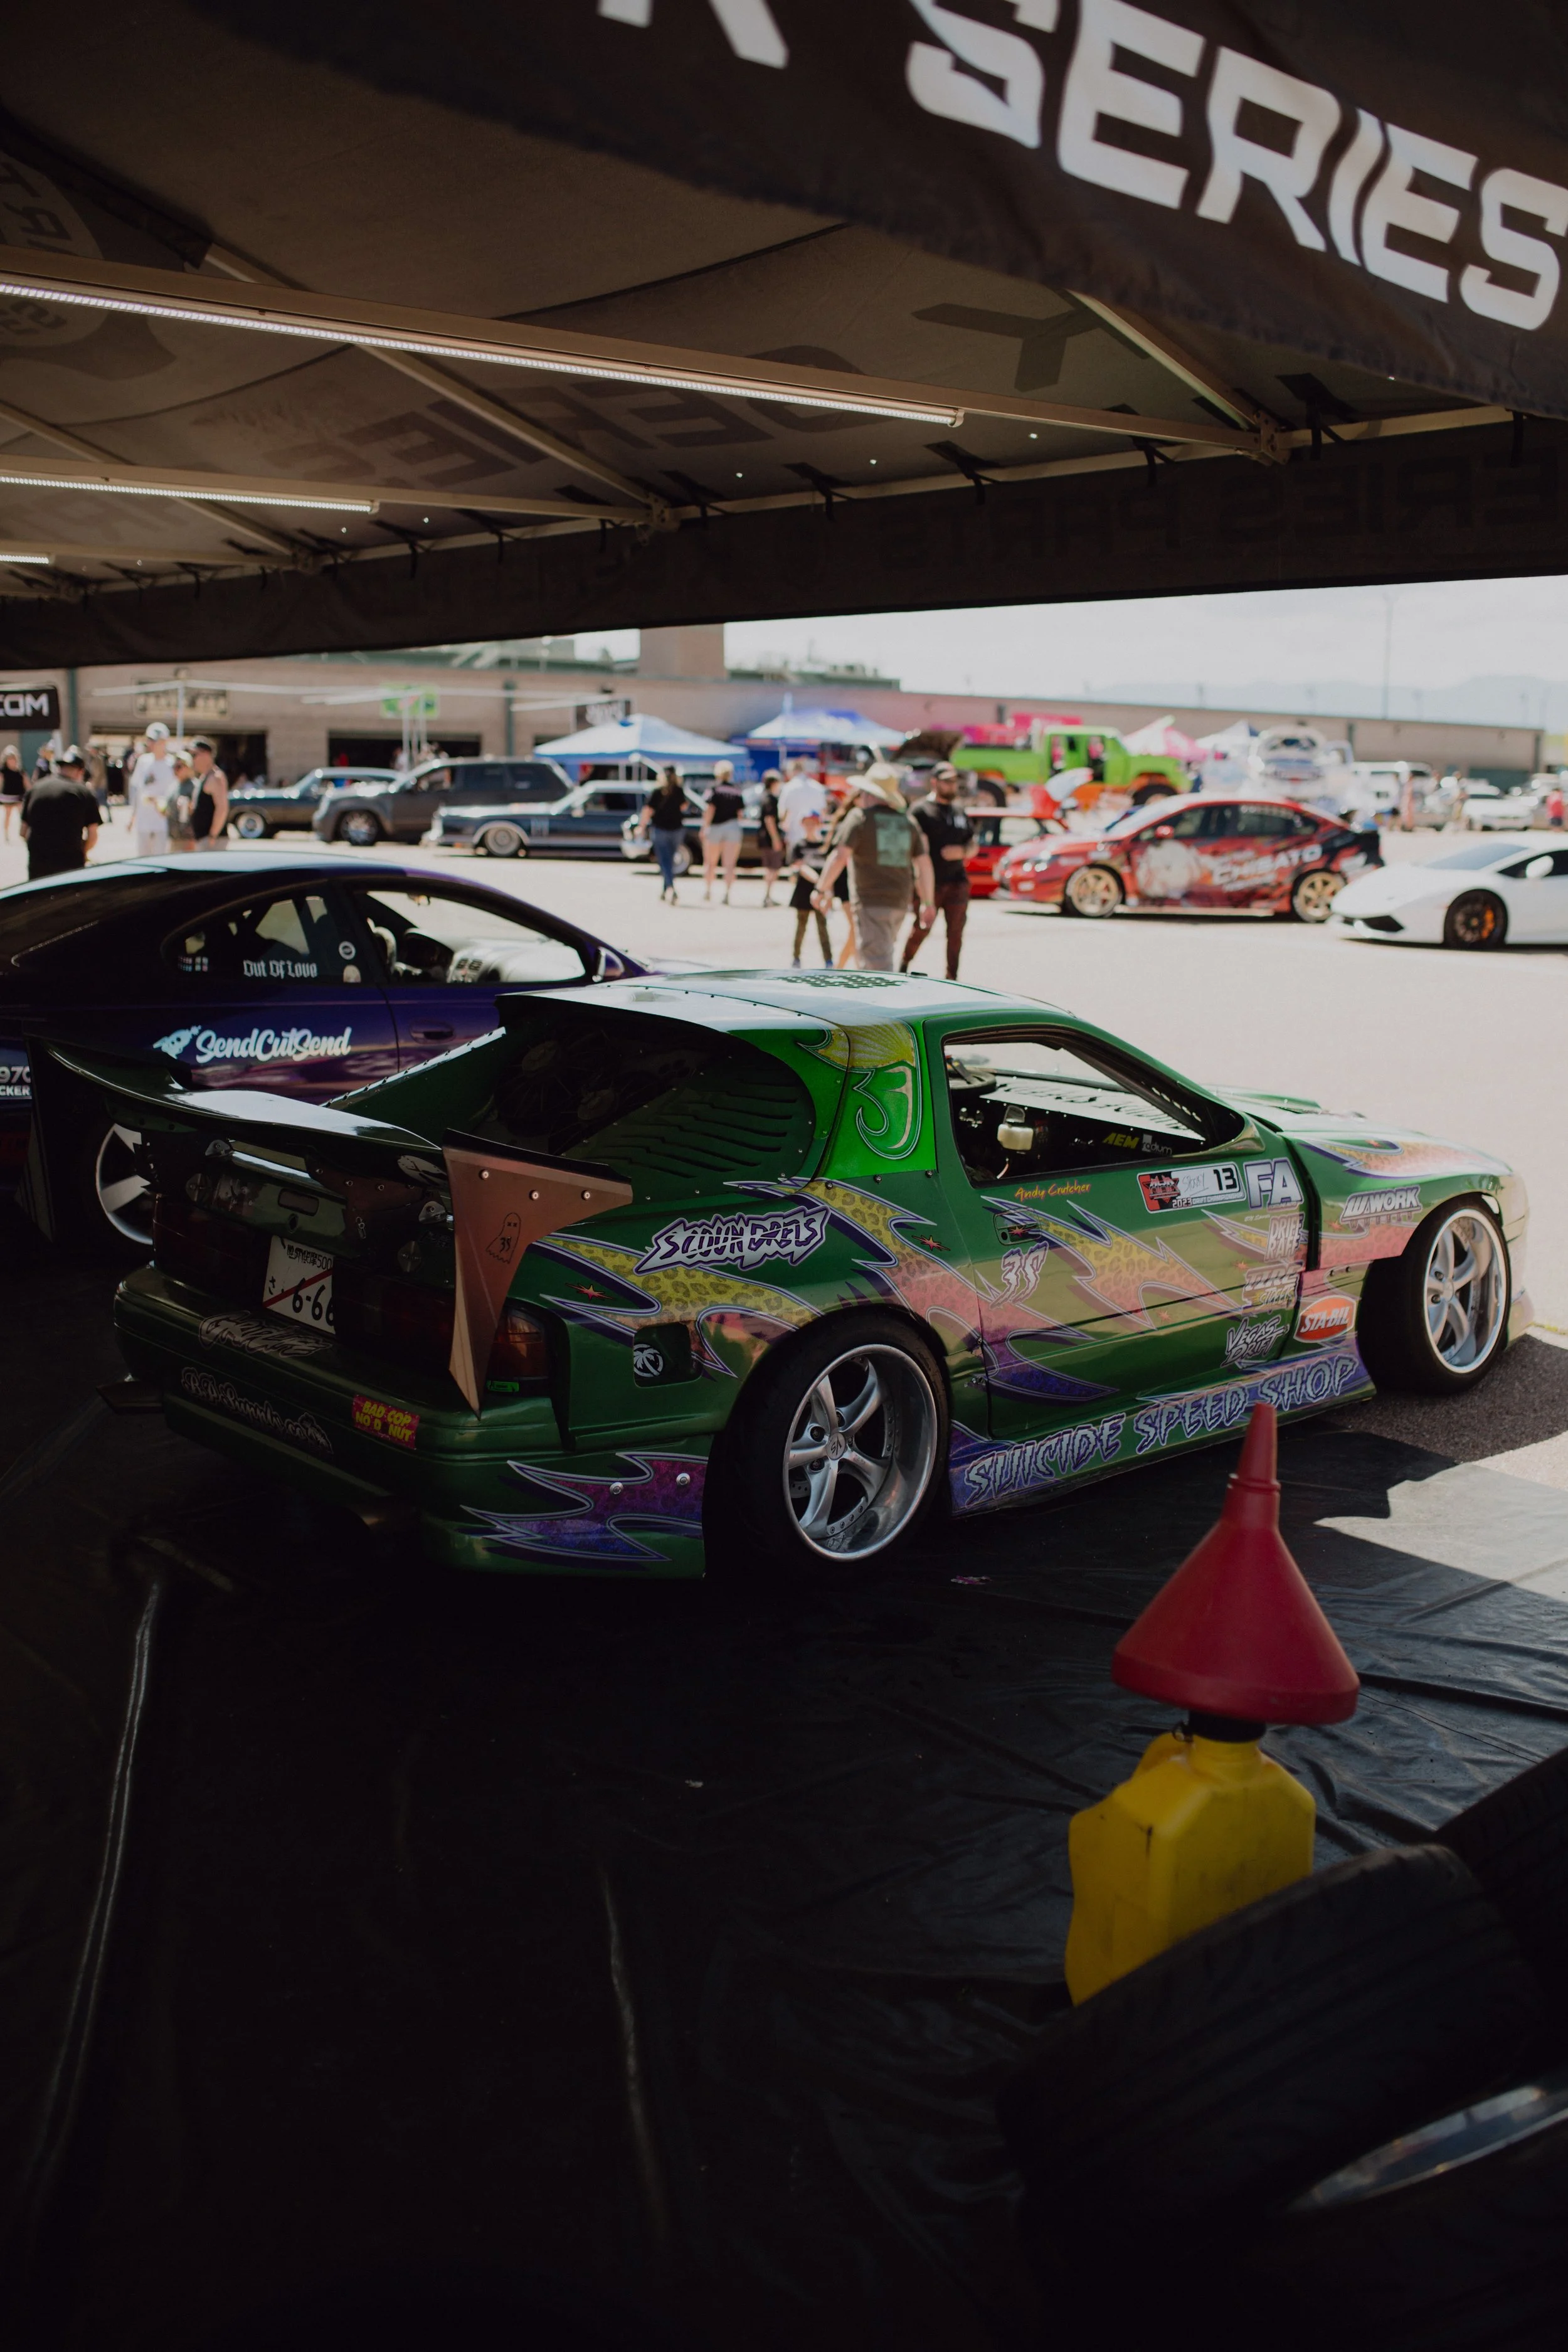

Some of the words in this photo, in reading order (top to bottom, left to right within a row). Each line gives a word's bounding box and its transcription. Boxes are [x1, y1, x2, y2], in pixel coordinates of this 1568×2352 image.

[904, 0, 1568, 331] SERIES
[0, 692, 50, 717] OM
[243, 959, 267, 977] Out
[287, 960, 318, 978] Love
[196, 1027, 352, 1063] SendCutSend
[1103, 1132, 1140, 1150] AEM
[1015, 1185, 1046, 1202] Andy
[1048, 1180, 1091, 1195] Crutcher
[1214, 1167, 1237, 1191] 13
[1172, 1197, 1192, 1208] 2023
[1227, 1316, 1281, 1352] VEGAS
[1221, 1327, 1287, 1367] DRIFT
[355, 1411, 371, 1427] NO
[362, 1400, 386, 1419] BAD
[386, 1409, 412, 1427] COP
[965, 1412, 1126, 1508] SUICIDE
[1135, 1387, 1248, 1454] SPEED
[1259, 1355, 1358, 1411] SHOP
